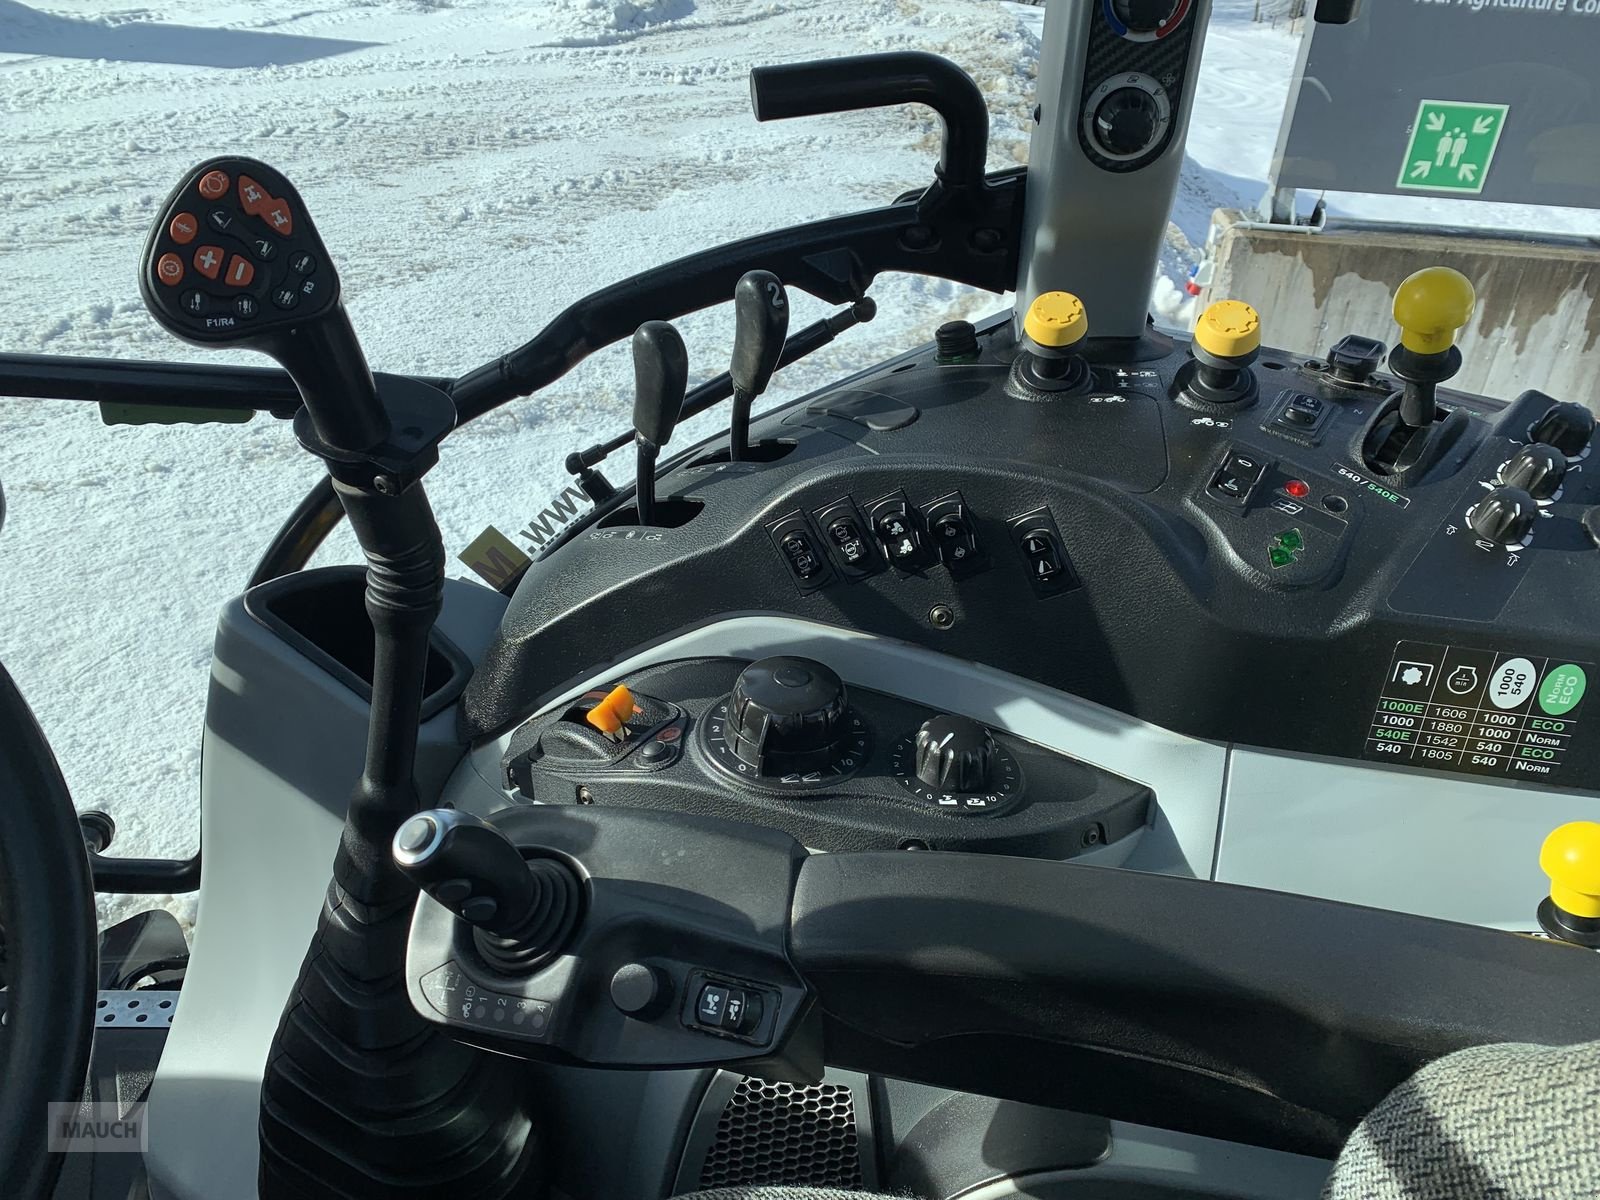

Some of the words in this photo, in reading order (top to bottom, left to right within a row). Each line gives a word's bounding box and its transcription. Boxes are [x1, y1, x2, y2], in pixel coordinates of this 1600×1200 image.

[303, 281, 315, 294] R3
[767, 282, 784, 306] 2
[206, 318, 235, 327] F1/R4
[1498, 668, 1516, 696] 1000
[1511, 673, 1527, 695] 540
[1558, 676, 1578, 705] ECO
[720, 705, 728, 714] 3
[1382, 700, 1424, 714] 1000E
[1435, 707, 1468, 719] 1606
[1483, 713, 1516, 726] 1000
[1531, 719, 1565, 732] ECO
[711, 725, 721, 733] 2
[1382, 715, 1415, 727] 1000
[1431, 721, 1463, 733] 1880
[1478, 727, 1511, 739] 1000
[1375, 728, 1411, 741] 540E
[1426, 735, 1458, 747] 1542
[1476, 741, 1502, 753] 540
[1521, 747, 1555, 759] ECO
[719, 746, 726, 754] 1
[1376, 743, 1402, 754] 540
[1421, 749, 1453, 761] 1805
[1472, 755, 1497, 766] 540
[737, 763, 747, 772] 0
[840, 758, 854, 766] 10
[497, 998, 508, 1006] 2
[516, 1001, 527, 1009] 3
[537, 1005, 546, 1013] 4
